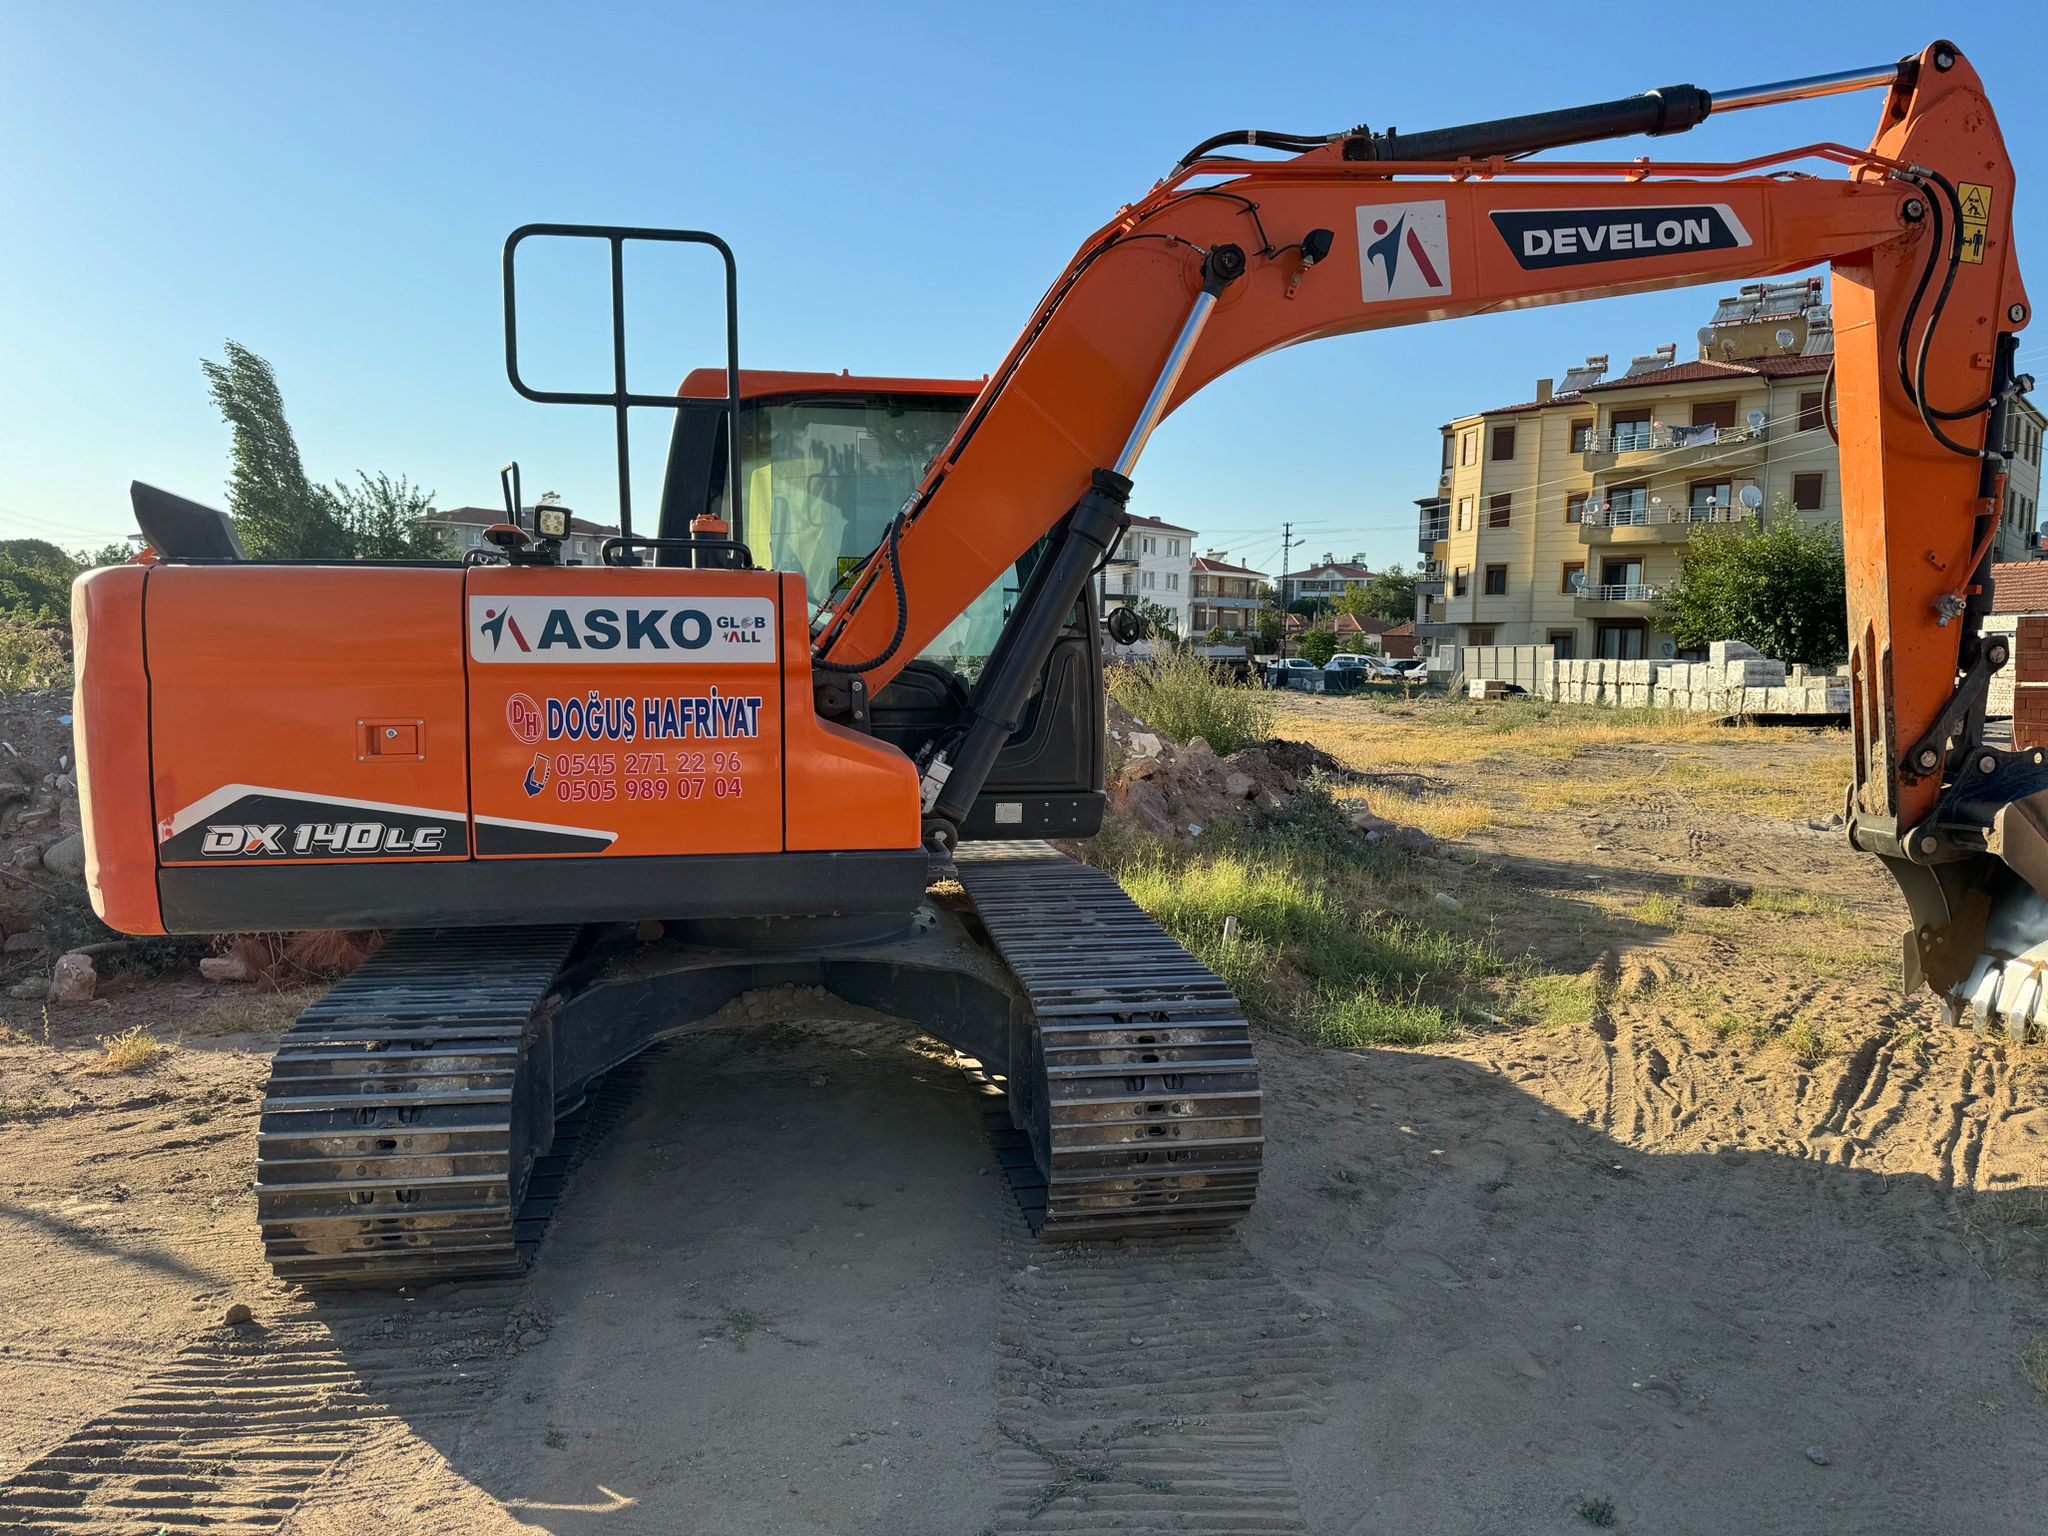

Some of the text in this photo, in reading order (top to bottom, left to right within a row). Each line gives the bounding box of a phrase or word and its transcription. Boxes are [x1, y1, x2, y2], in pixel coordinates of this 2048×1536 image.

[1523, 217, 1711, 257] DEVELON
[537, 608, 713, 650] ASKO
[727, 630, 761, 643] ALL
[512, 699, 539, 738] DH
[547, 685, 762, 743] DOĞUŞ HAFRİYAT
[556, 752, 742, 777] 0545 271 22 96
[556, 777, 743, 802] 0505 989 07 04
[201, 824, 287, 856] DX
